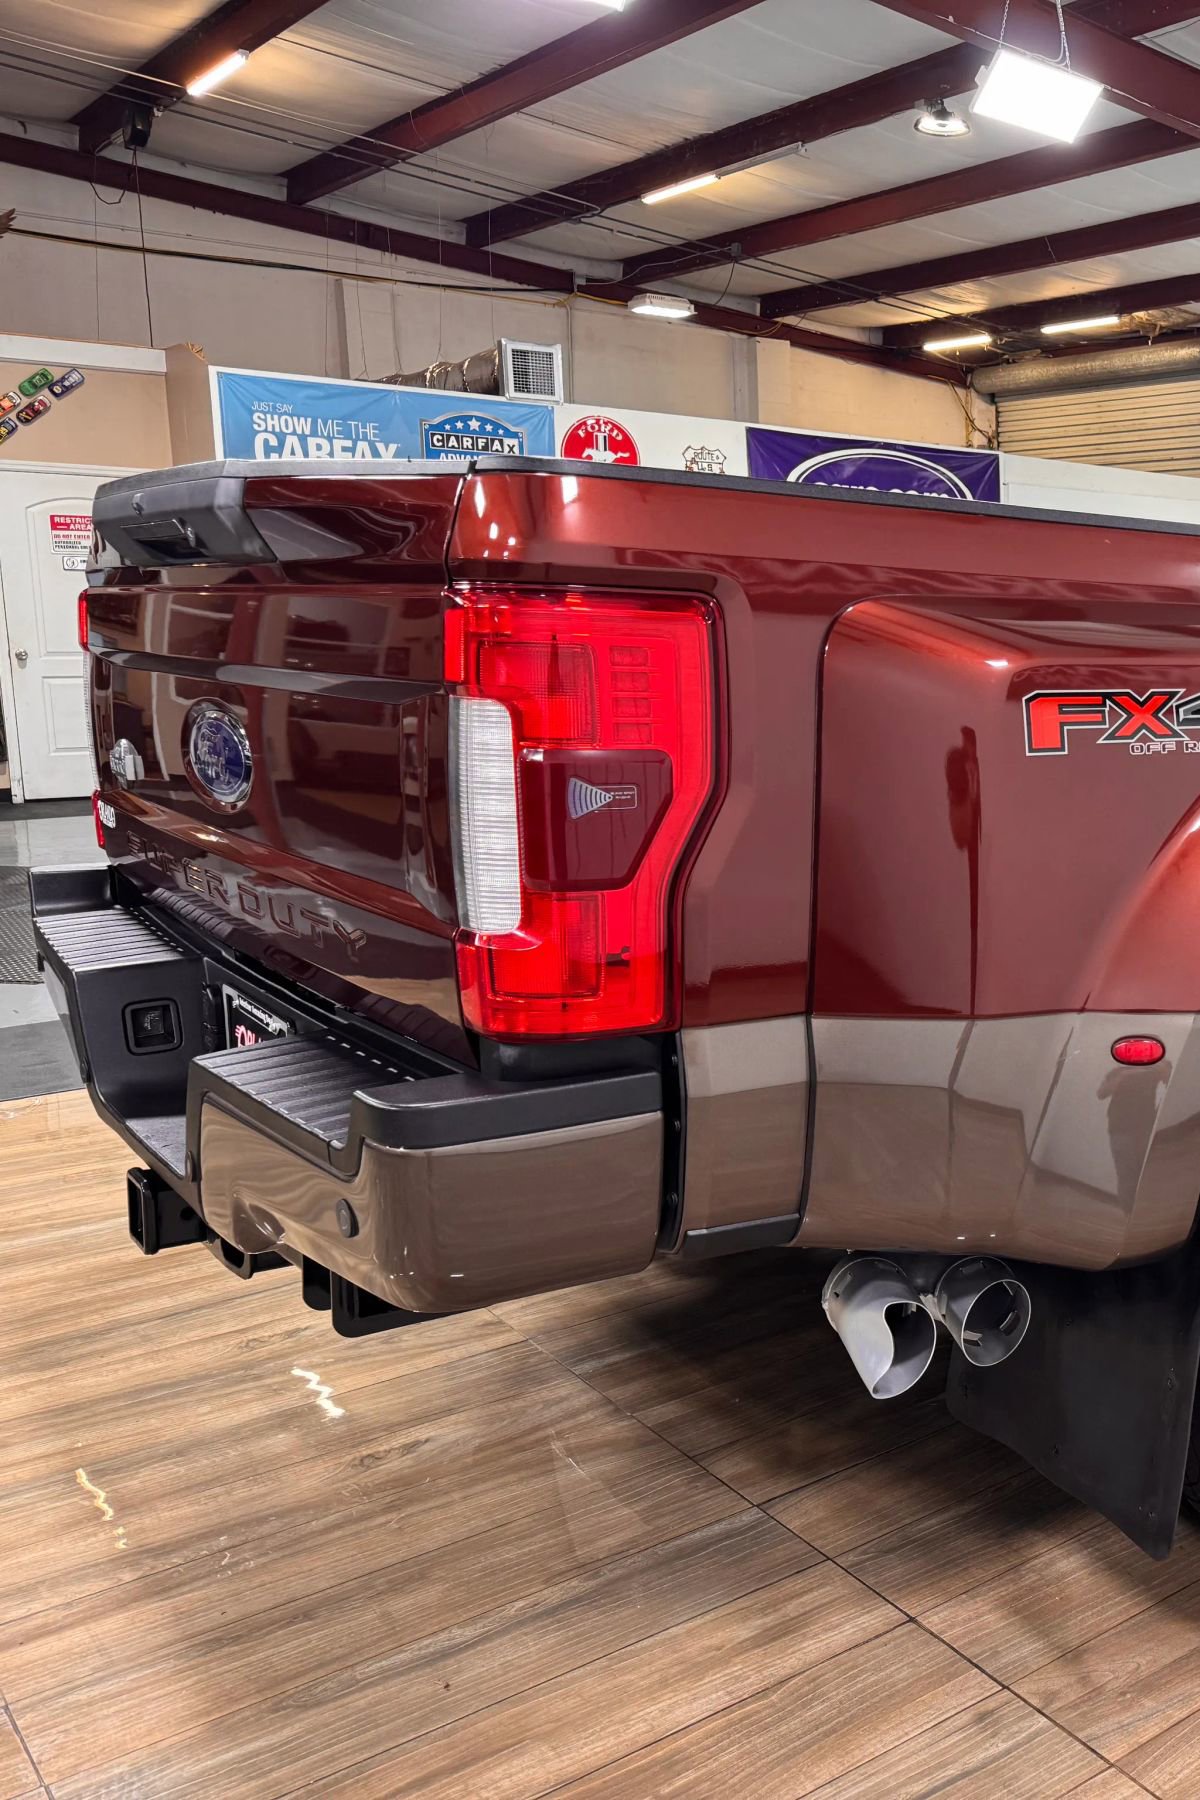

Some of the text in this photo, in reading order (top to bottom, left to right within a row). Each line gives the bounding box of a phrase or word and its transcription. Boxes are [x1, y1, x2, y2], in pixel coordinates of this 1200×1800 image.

[252, 401, 293, 414] JUST SAY
[253, 412, 380, 441] SHOW ME THE
[577, 421, 623, 441] FORD
[431, 434, 517, 455] CARFAX
[693, 451, 715, 461] ROUTE
[1129, 742, 1176, 755] OFF
[127, 830, 367, 963] SUPER DUTY
